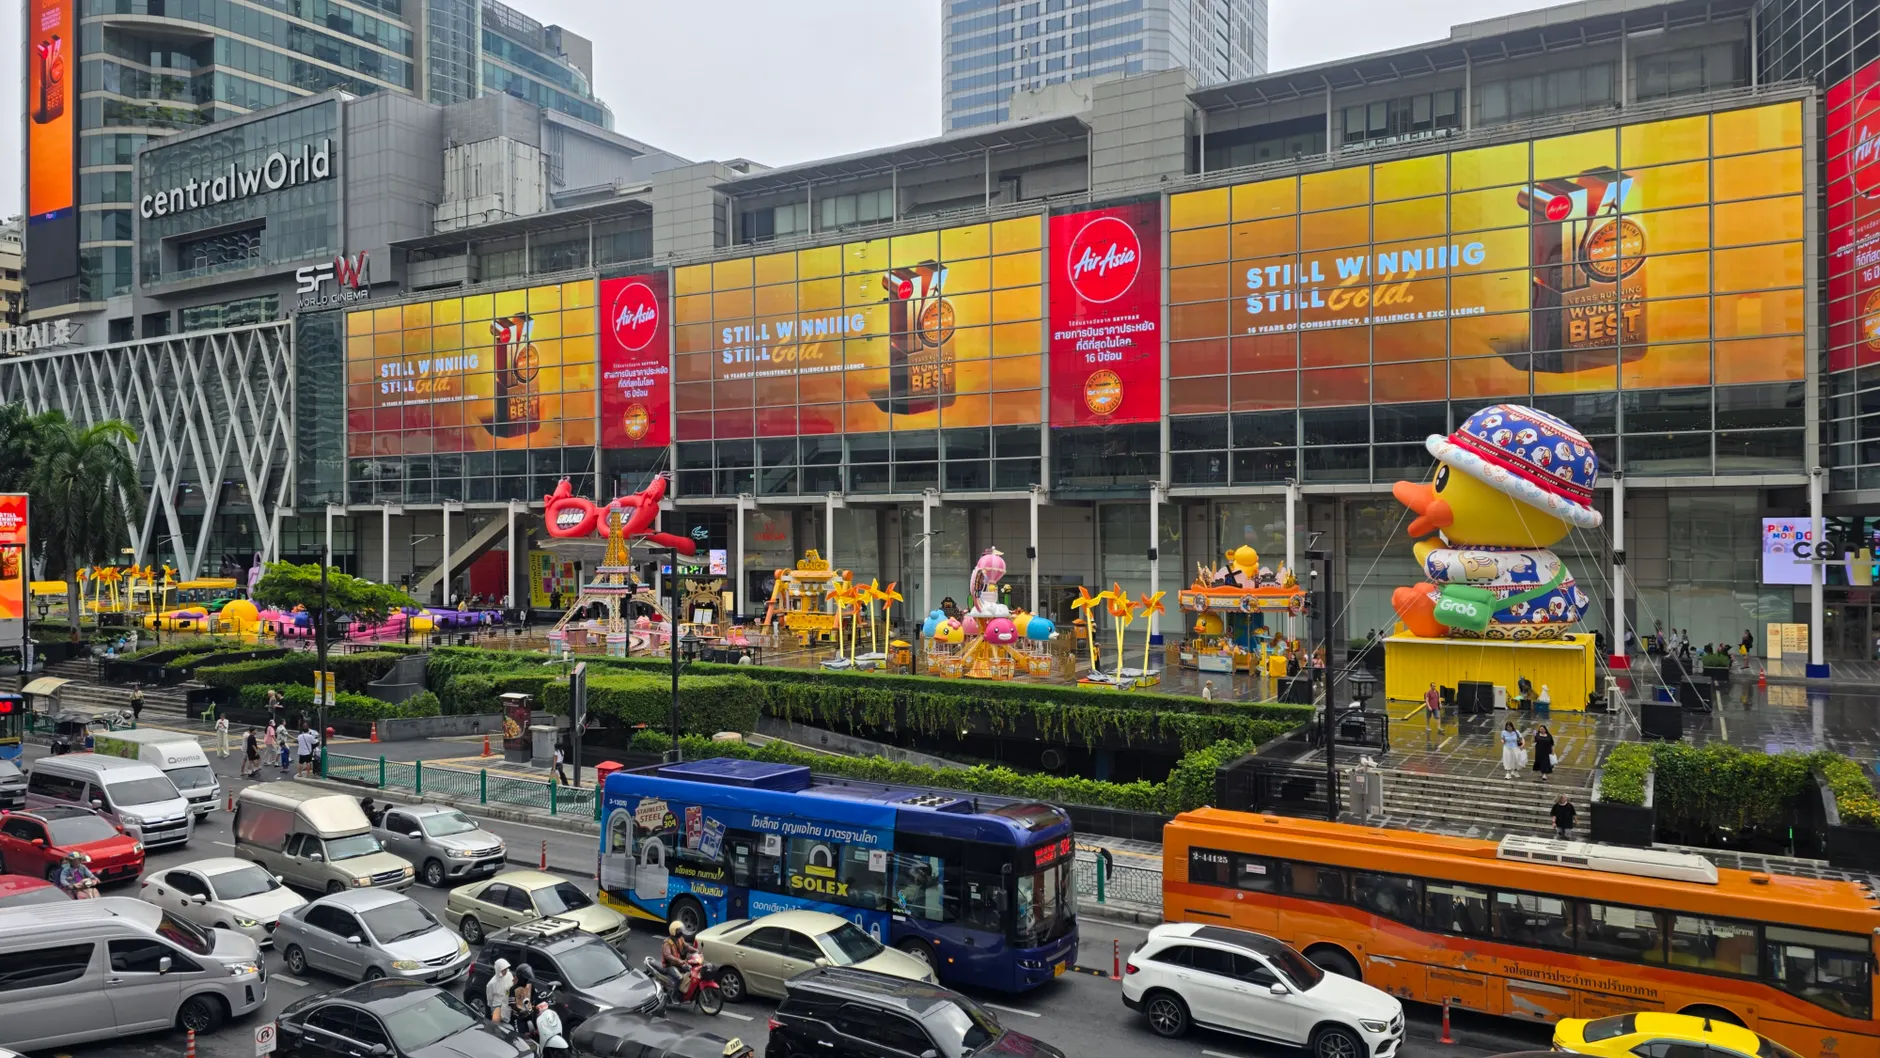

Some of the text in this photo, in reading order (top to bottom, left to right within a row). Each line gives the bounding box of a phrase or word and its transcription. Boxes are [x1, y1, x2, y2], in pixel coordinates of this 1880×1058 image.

[141, 139, 331, 219] centralwOrld
[1247, 261, 1325, 289] STILL
[297, 289, 368, 307] WORLD CINEMA
[1247, 287, 1325, 314] STILL
[1569, 295, 1597, 304] YEARS
[1054, 320, 1155, 340] สายการบินราคาประหยัด
[1258, 324, 1284, 333] YEARS
[1286, 322, 1297, 331] OF
[1364, 312, 1415, 325] RSILIENCE
[1570, 309, 1641, 343] BEST
[723, 326, 770, 344] STILL
[1076, 335, 1132, 352] ที่ดีที่สุดในโลก
[723, 344, 770, 365] STILL
[1085, 350, 1122, 363] 16 ปีซ้อน
[381, 355, 479, 378] STILL WNNING
[381, 379, 415, 395] STILL
[912, 368, 952, 392] BEST
[556, 513, 584, 524] GRAND
[1768, 524, 1795, 533] PLAY
[1440, 599, 1477, 617] Grab
[636, 804, 666, 816] STAINLESS
[640, 812, 662, 823] STEEL
[664, 819, 676, 828] 304
[1192, 851, 1228, 864] 2-44125
[791, 875, 848, 897] SOLEX
[1503, 962, 1658, 998] รถโดยสารประจำทางปรับอากาศ
